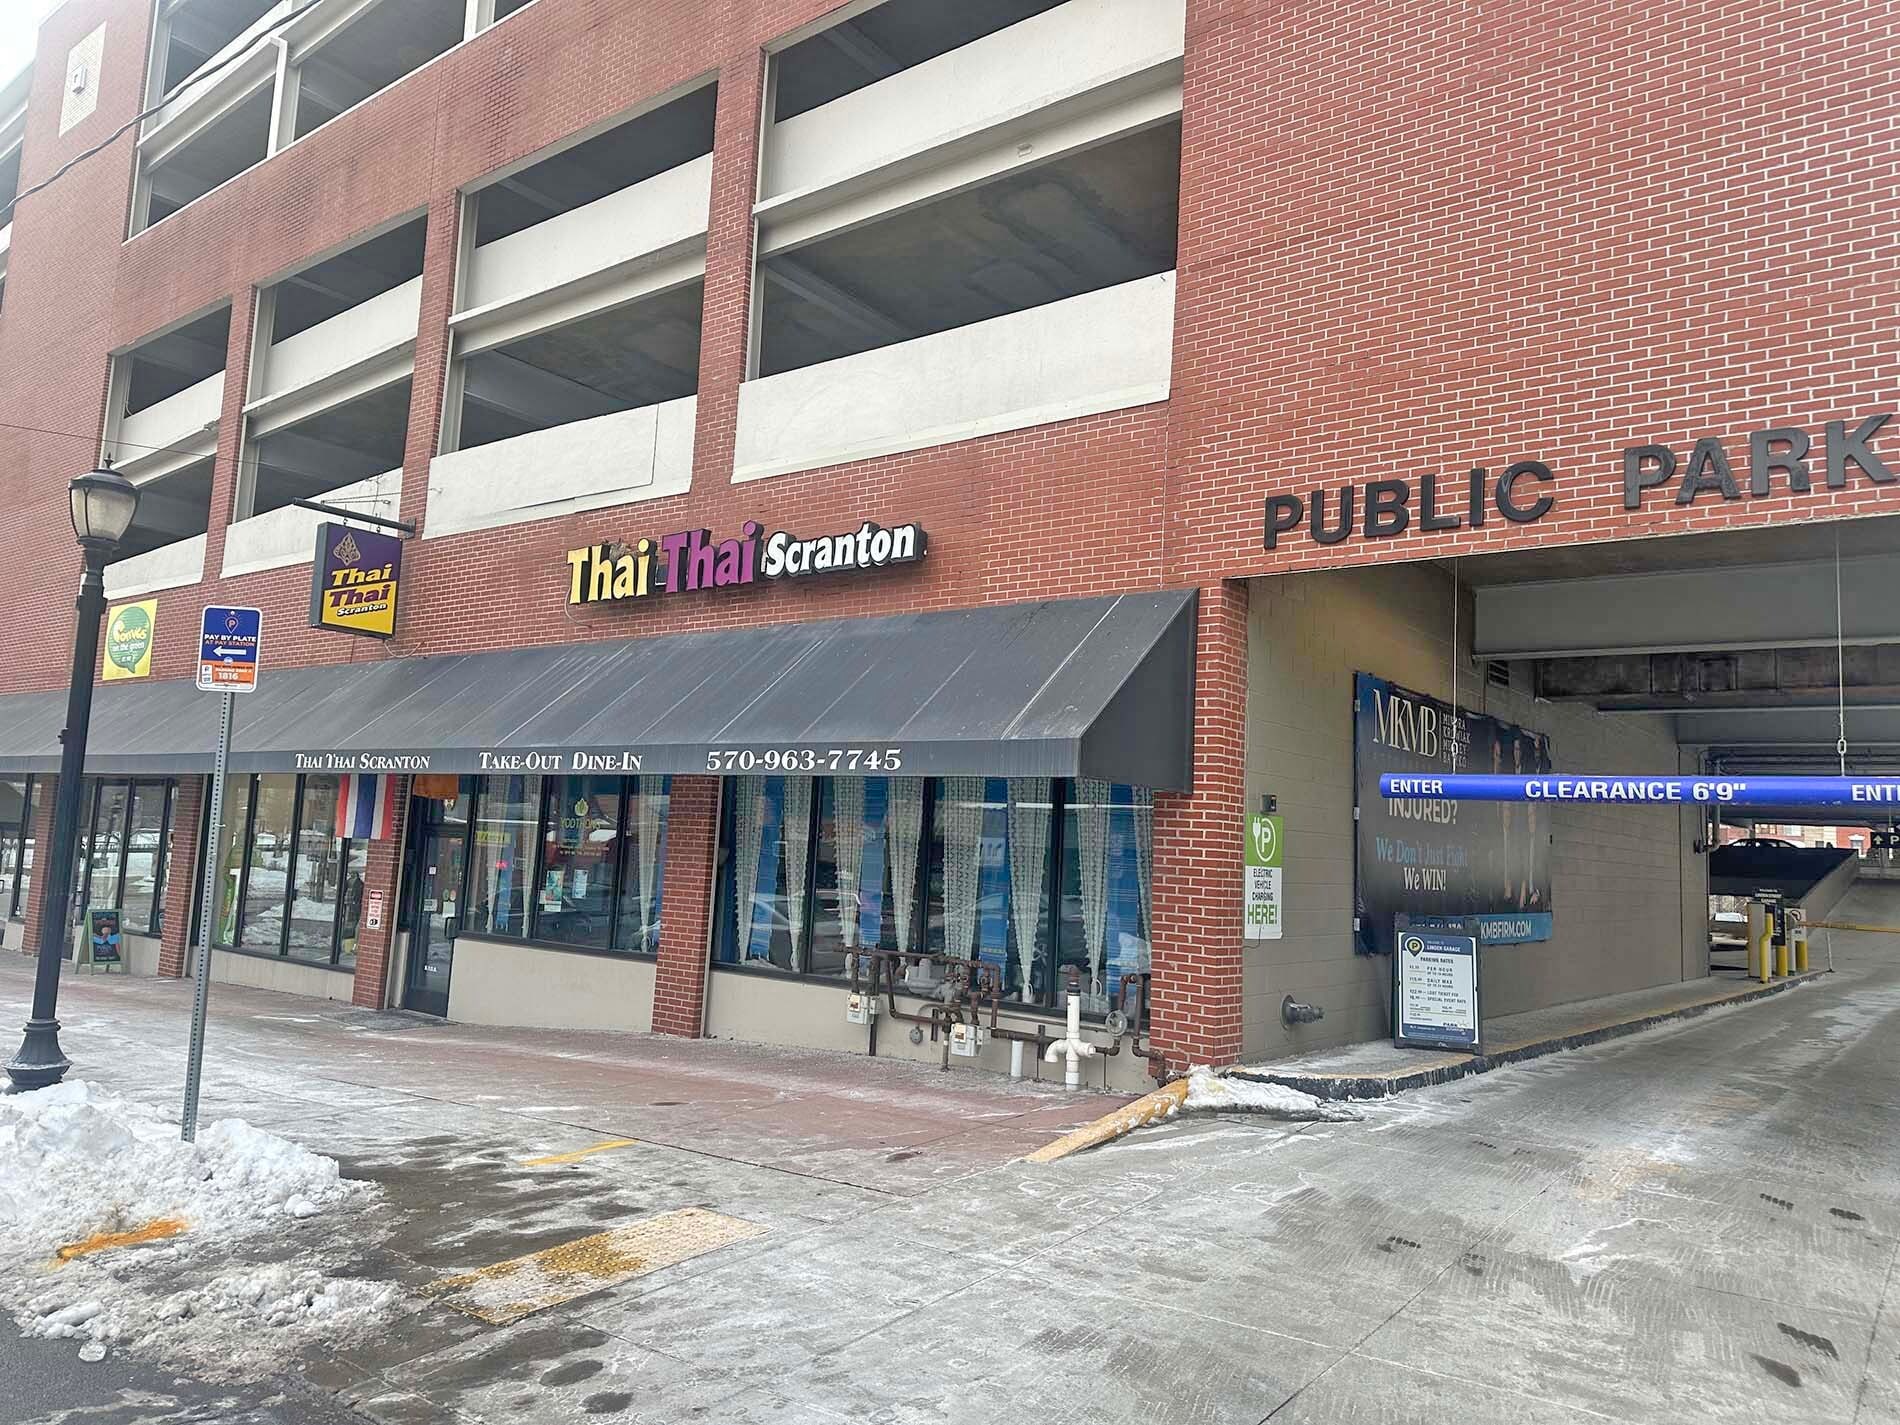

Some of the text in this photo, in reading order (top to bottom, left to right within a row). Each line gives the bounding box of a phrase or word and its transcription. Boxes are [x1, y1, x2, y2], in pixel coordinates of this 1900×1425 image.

[1263, 413, 1898, 550] PUBLIC PARK
[567, 520, 916, 604] Thai Thai Scranton
[331, 564, 393, 586] Thai
[330, 584, 391, 608] Thai
[337, 603, 388, 617] Scranton
[218, 672, 239, 680] 1816
[1372, 689, 1438, 758] MKMB
[1443, 713, 1466, 731] MIRA
[1443, 726, 1471, 745] KRWIAK
[1443, 739, 1467, 755] MUEY
[295, 753, 430, 769] THAI THAI SCRANTON
[479, 751, 643, 770] TAKE-OUT DINE-IN
[705, 748, 902, 771] 570-963-7745
[1390, 779, 1900, 801] ENTER CLEARANCE 6'9" ENT
[1389, 798, 1458, 825] INJURED?
[1376, 837, 1393, 863] We
[1253, 868, 1273, 878] ELECTRIC
[1403, 867, 1447, 892] We WIN!
[1254, 880, 1272, 890] VEHICLE
[1252, 891, 1274, 902] CHARGING
[1247, 904, 1278, 925] HERE!
[1479, 918, 1532, 940] KMBFIRM.COM
